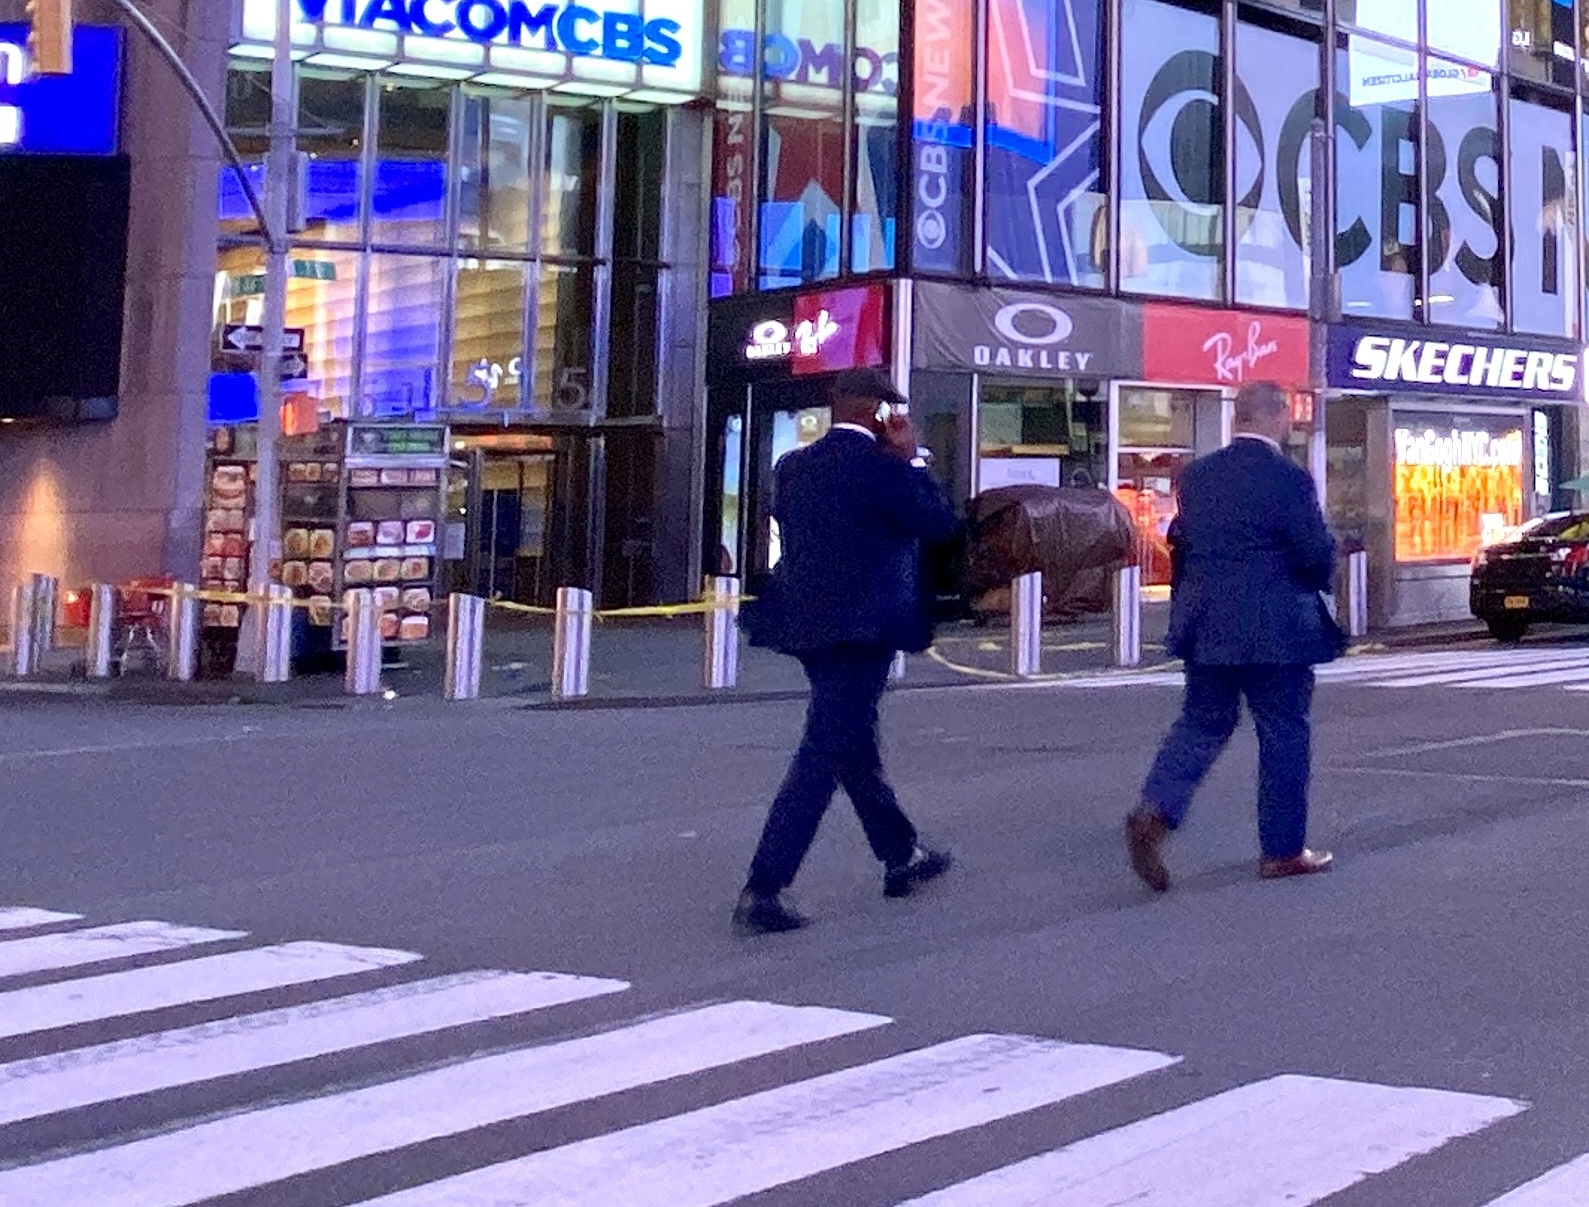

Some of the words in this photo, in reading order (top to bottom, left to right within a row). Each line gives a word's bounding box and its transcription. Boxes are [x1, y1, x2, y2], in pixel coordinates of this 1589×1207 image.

[1276, 87, 1515, 288] CBS
[974, 345, 1090, 371] OAKLEY
[1352, 335, 1578, 391] SKECHERS
